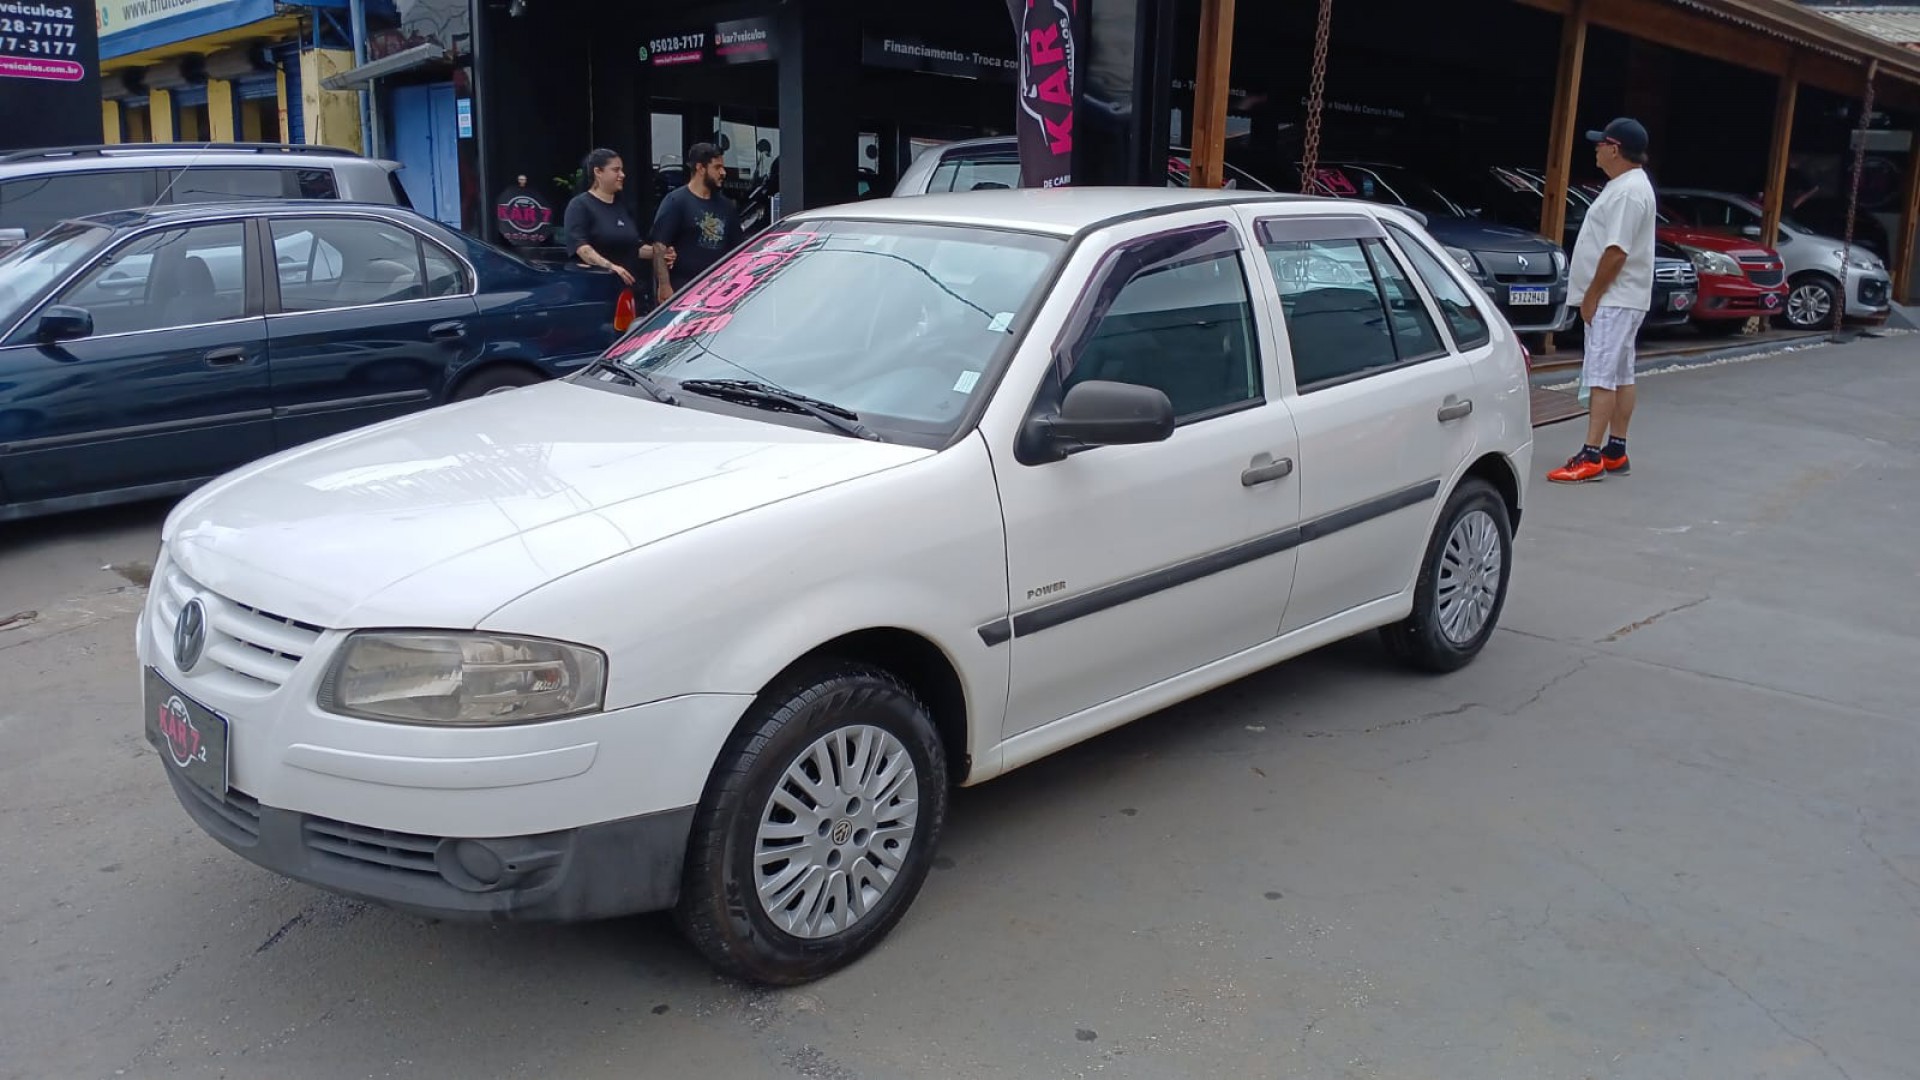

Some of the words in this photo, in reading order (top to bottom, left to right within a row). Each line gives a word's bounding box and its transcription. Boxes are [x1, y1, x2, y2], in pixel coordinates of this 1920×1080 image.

[649, 33, 704, 54] 95028-7177
[883, 39, 964, 62] Financiamento
[973, 52, 1002, 67] Troca
[1030, 22, 1074, 155] KAR
[1026, 581, 1066, 600] POWER
